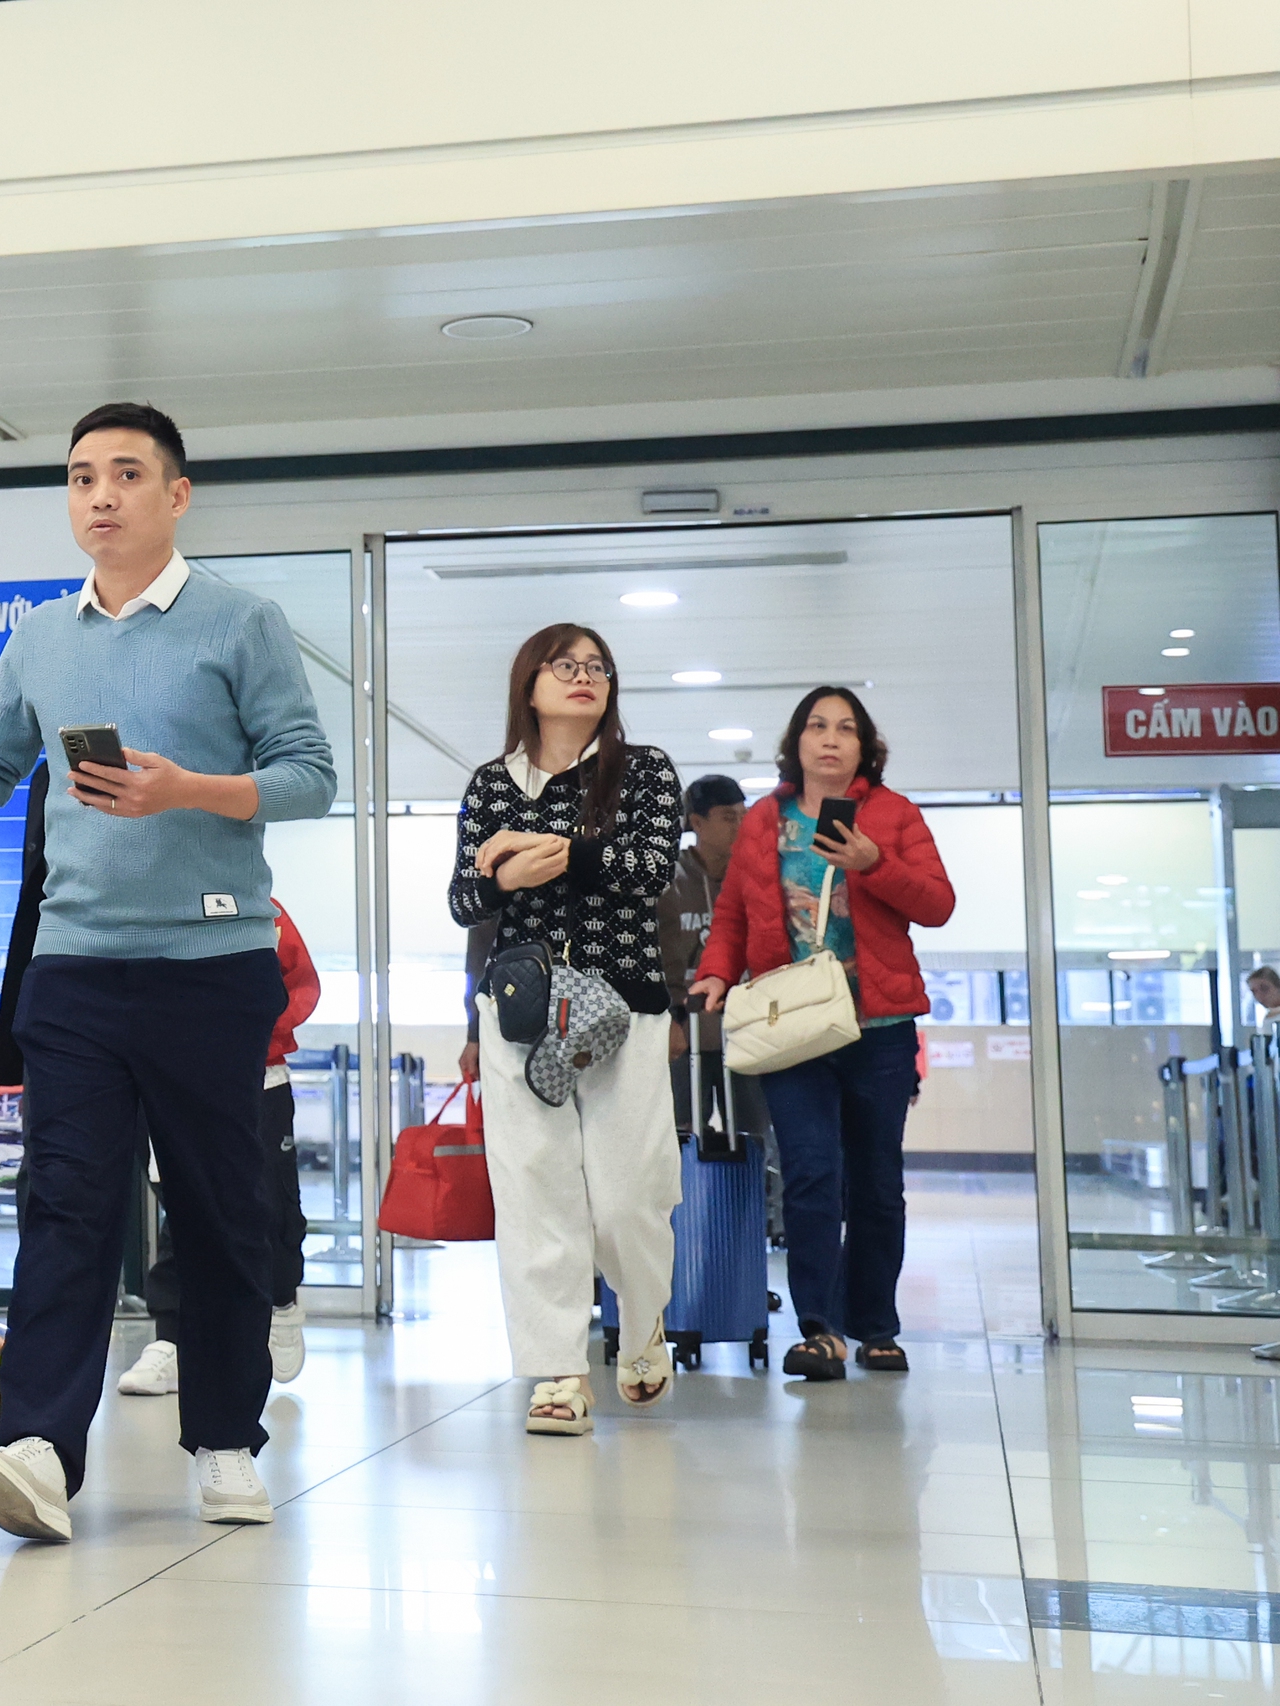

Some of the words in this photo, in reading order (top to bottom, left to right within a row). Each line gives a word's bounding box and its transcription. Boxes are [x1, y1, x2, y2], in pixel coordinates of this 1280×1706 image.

[1125, 699, 1201, 739] CẤM
[1211, 700, 1279, 737] VÀO
[681, 912, 713, 931] WAR
